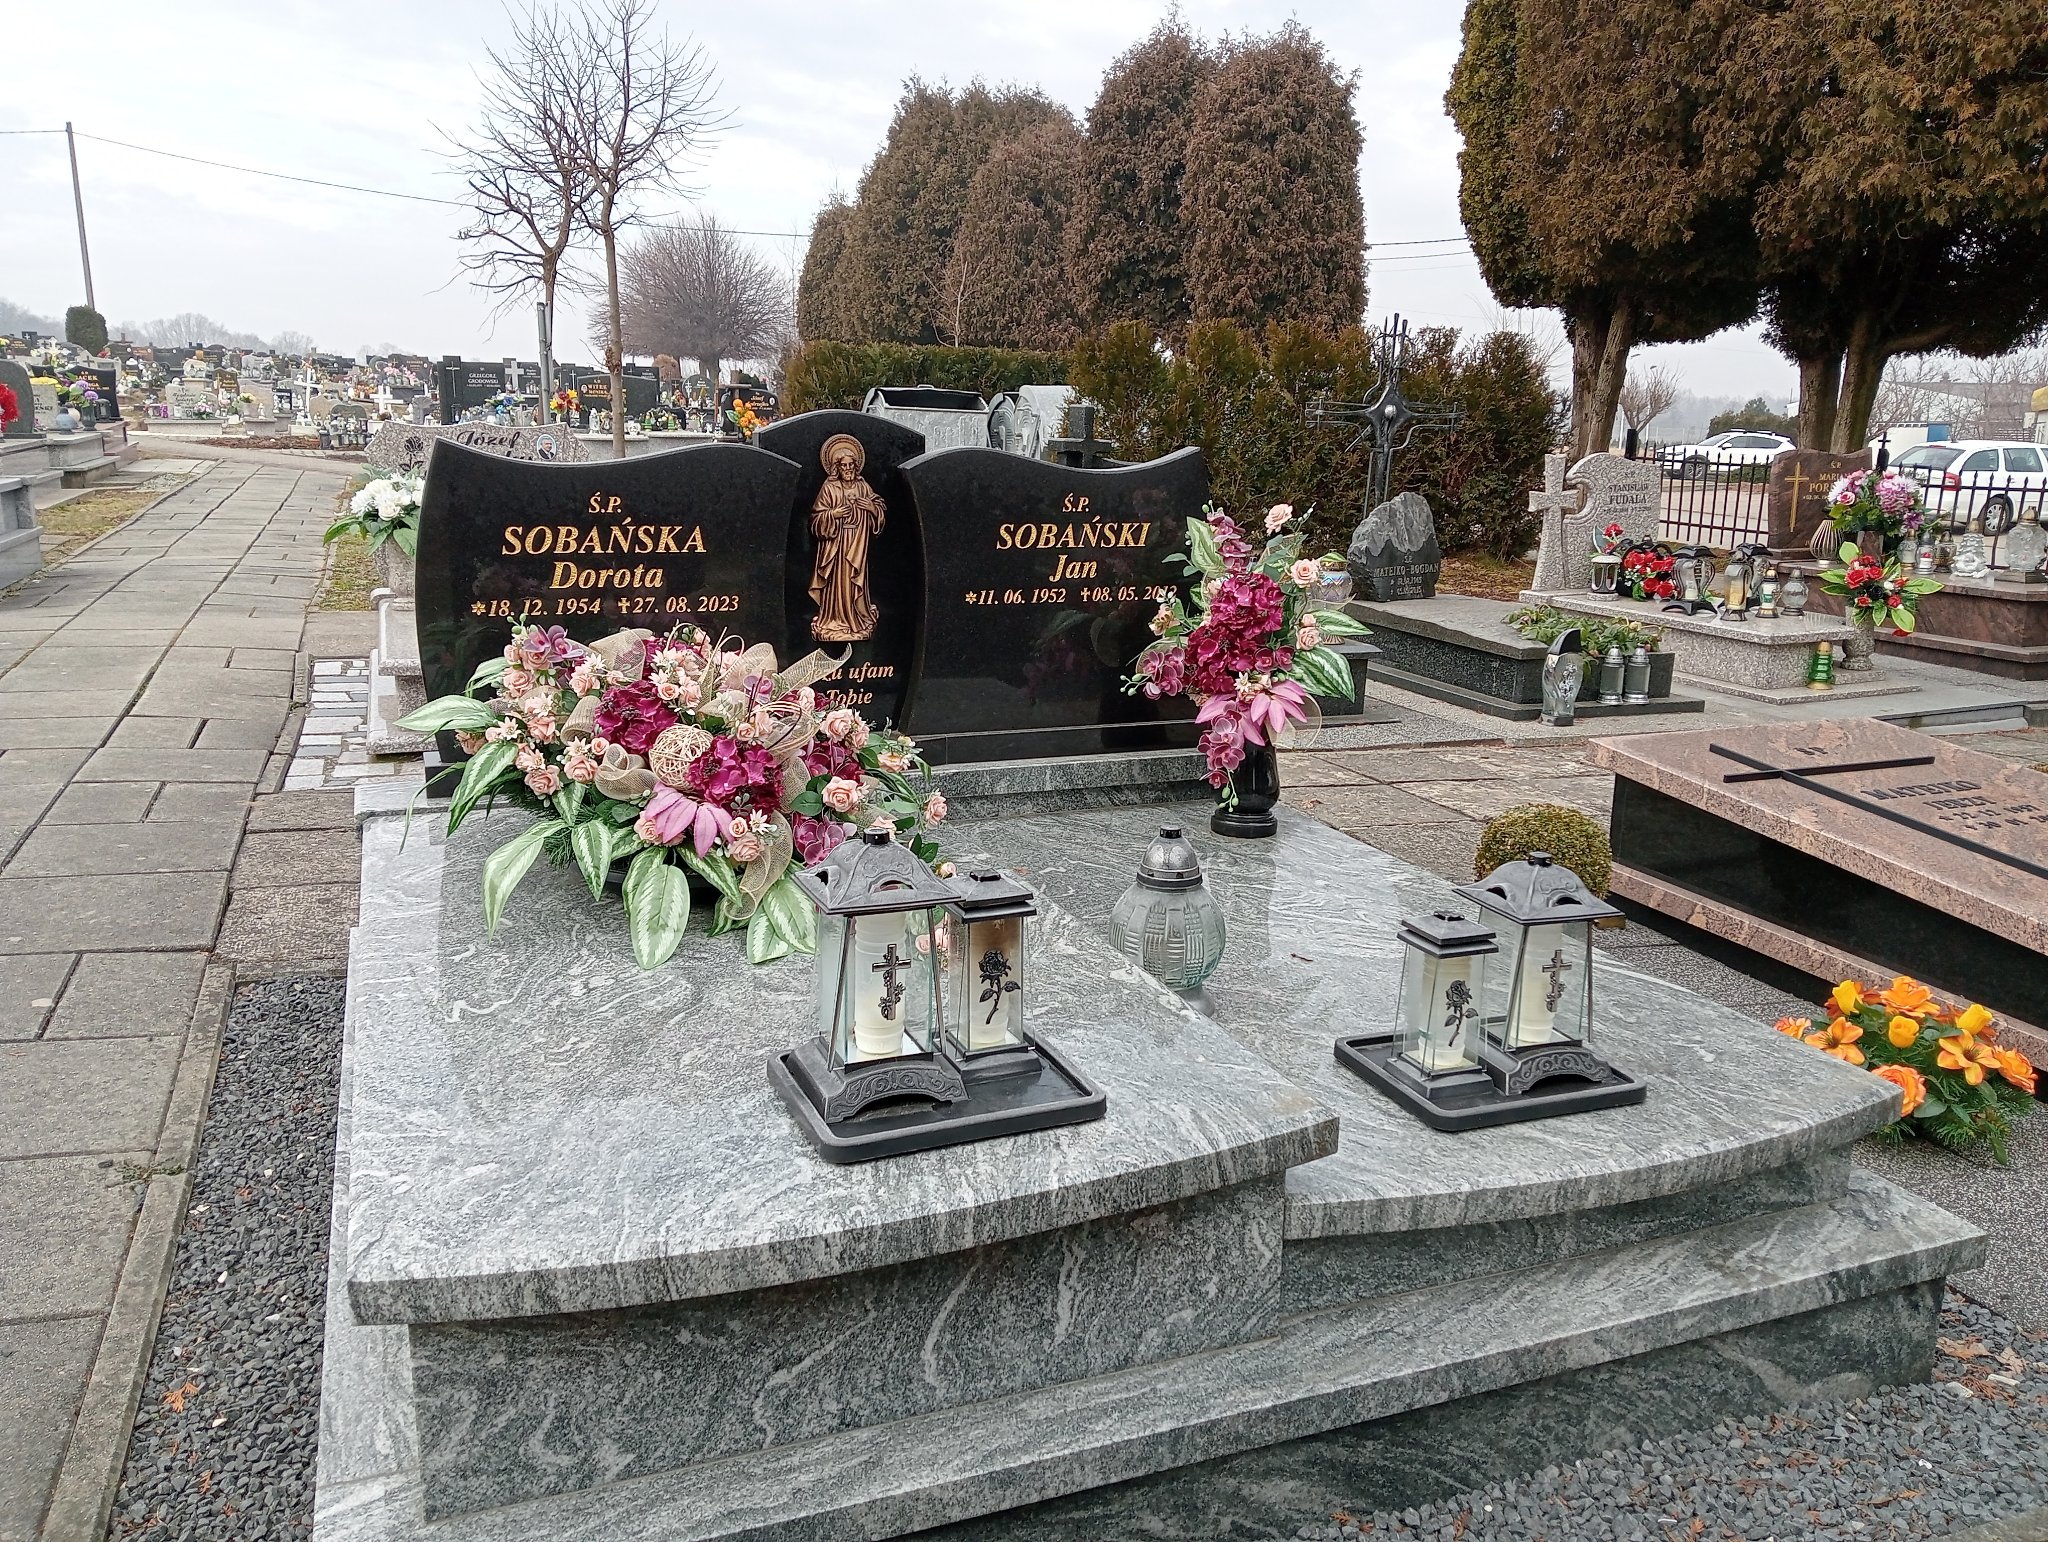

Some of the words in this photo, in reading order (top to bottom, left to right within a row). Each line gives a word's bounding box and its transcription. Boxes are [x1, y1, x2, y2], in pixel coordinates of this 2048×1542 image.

[457, 431, 520, 448] Józef
[502, 517, 707, 556] SOBAŃSKA
[996, 515, 1151, 550] SOBAŃSKI
[549, 561, 664, 589] Dorota
[1049, 554, 1098, 582] Jan
[523, 599, 548, 616] 12.
[555, 597, 602, 614] 1954
[665, 596, 692, 613] 08.
[697, 595, 739, 612] 2023
[1003, 589, 1026, 605] 06.
[1031, 588, 1067, 603] 1952
[1118, 586, 1139, 601] 05.
[848, 662, 894, 683] ufam
[827, 688, 873, 707] Tobie
